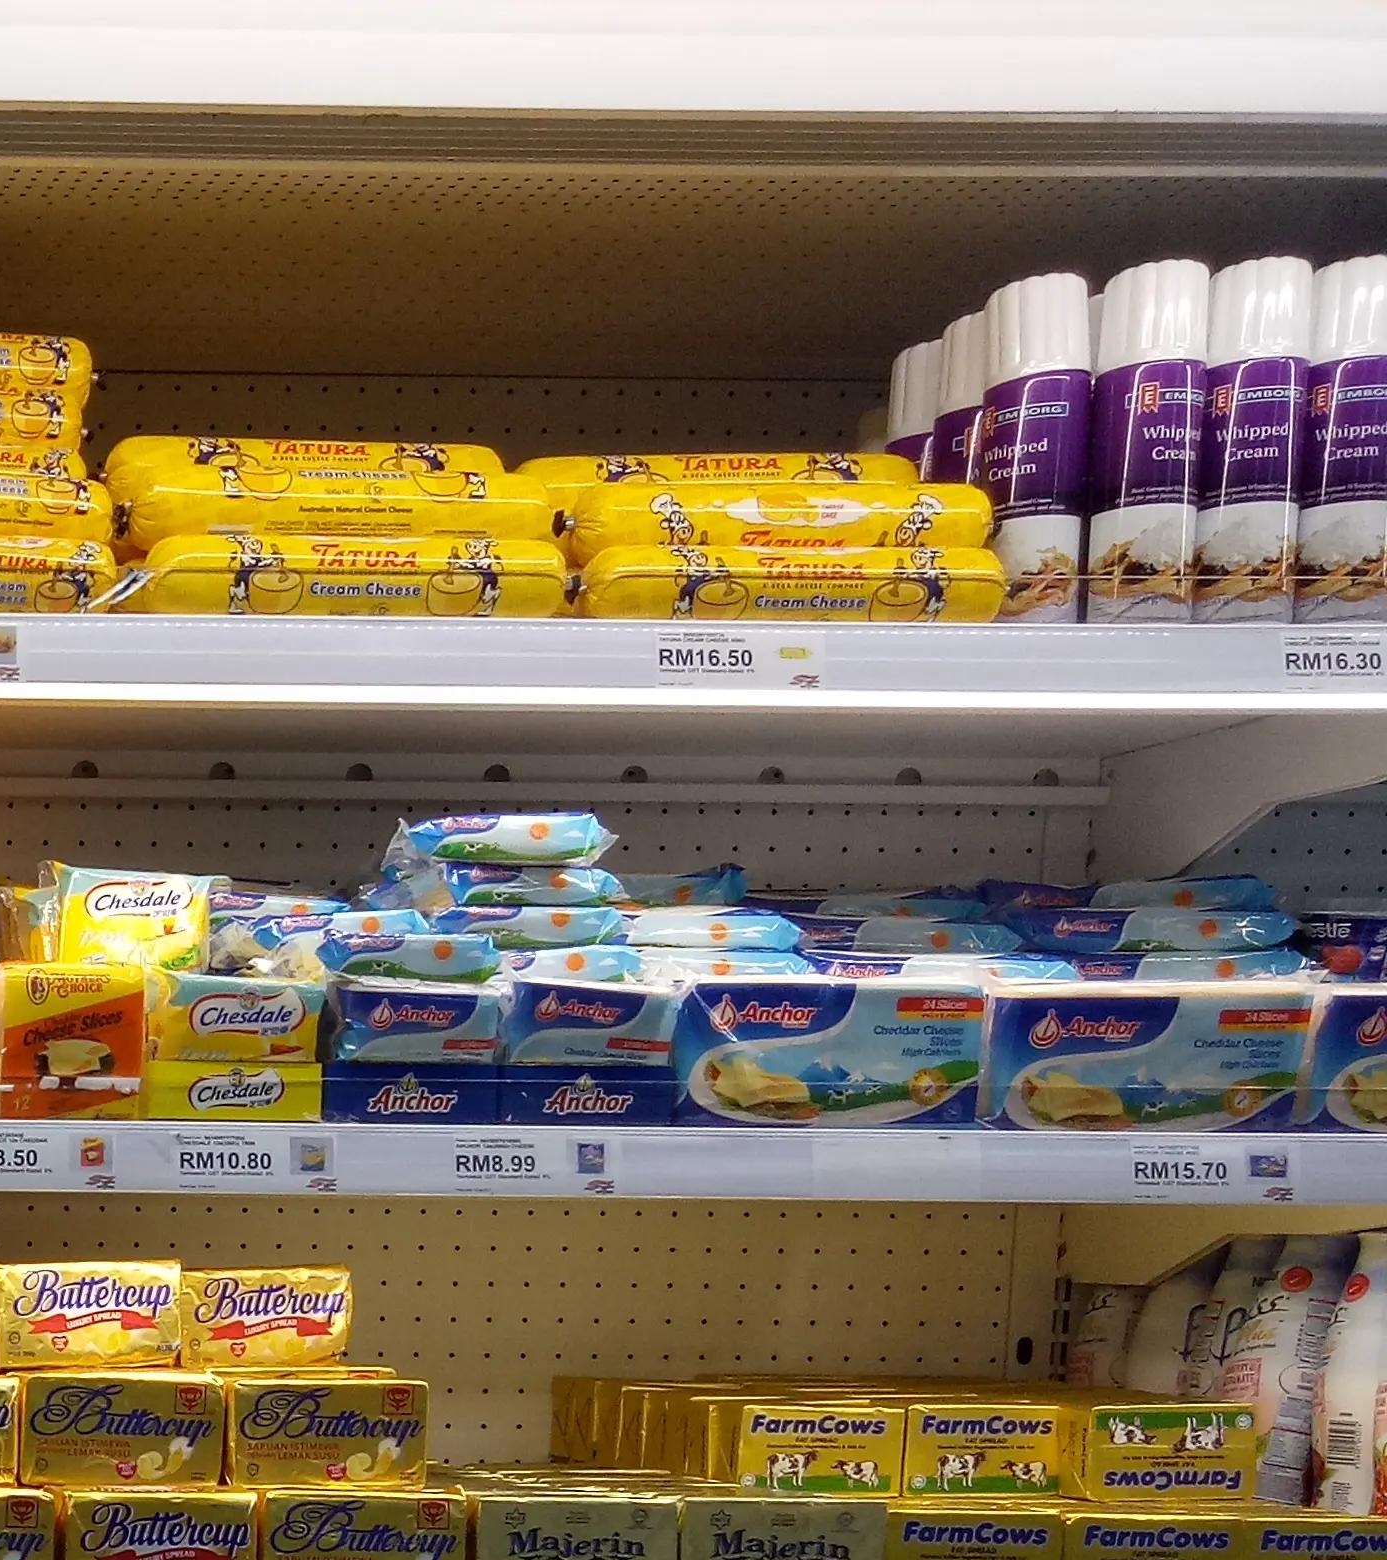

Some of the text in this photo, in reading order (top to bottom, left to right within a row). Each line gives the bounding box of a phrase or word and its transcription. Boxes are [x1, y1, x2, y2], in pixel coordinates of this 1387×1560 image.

[1215, 421, 1290, 443] Whipped
[1224, 442, 1280, 461] Cream
[988, 459, 1037, 481] Cream
[311, 542, 421, 568] TATURA
[310, 580, 422, 597] Cream Cheese
[659, 647, 753, 669] RM16.50
[1286, 650, 1382, 672] RM16.30
[199, 1006, 291, 1026] Chesdale
[738, 1001, 816, 1025] Anchor
[874, 1026, 920, 1035] Cheddar
[368, 1090, 458, 1115] Anchor
[180, 1151, 272, 1171] RM10.80
[455, 1153, 535, 1173] RM8.99
[1134, 1161, 1227, 1181] RM15.70
[14, 1269, 172, 1316] Buttercup
[29, 1384, 216, 1439] Buttercup
[1104, 1470, 1241, 1490] FarmCows
[508, 1526, 647, 1560] Majerin
[902, 1521, 1048, 1548] FarmCows
